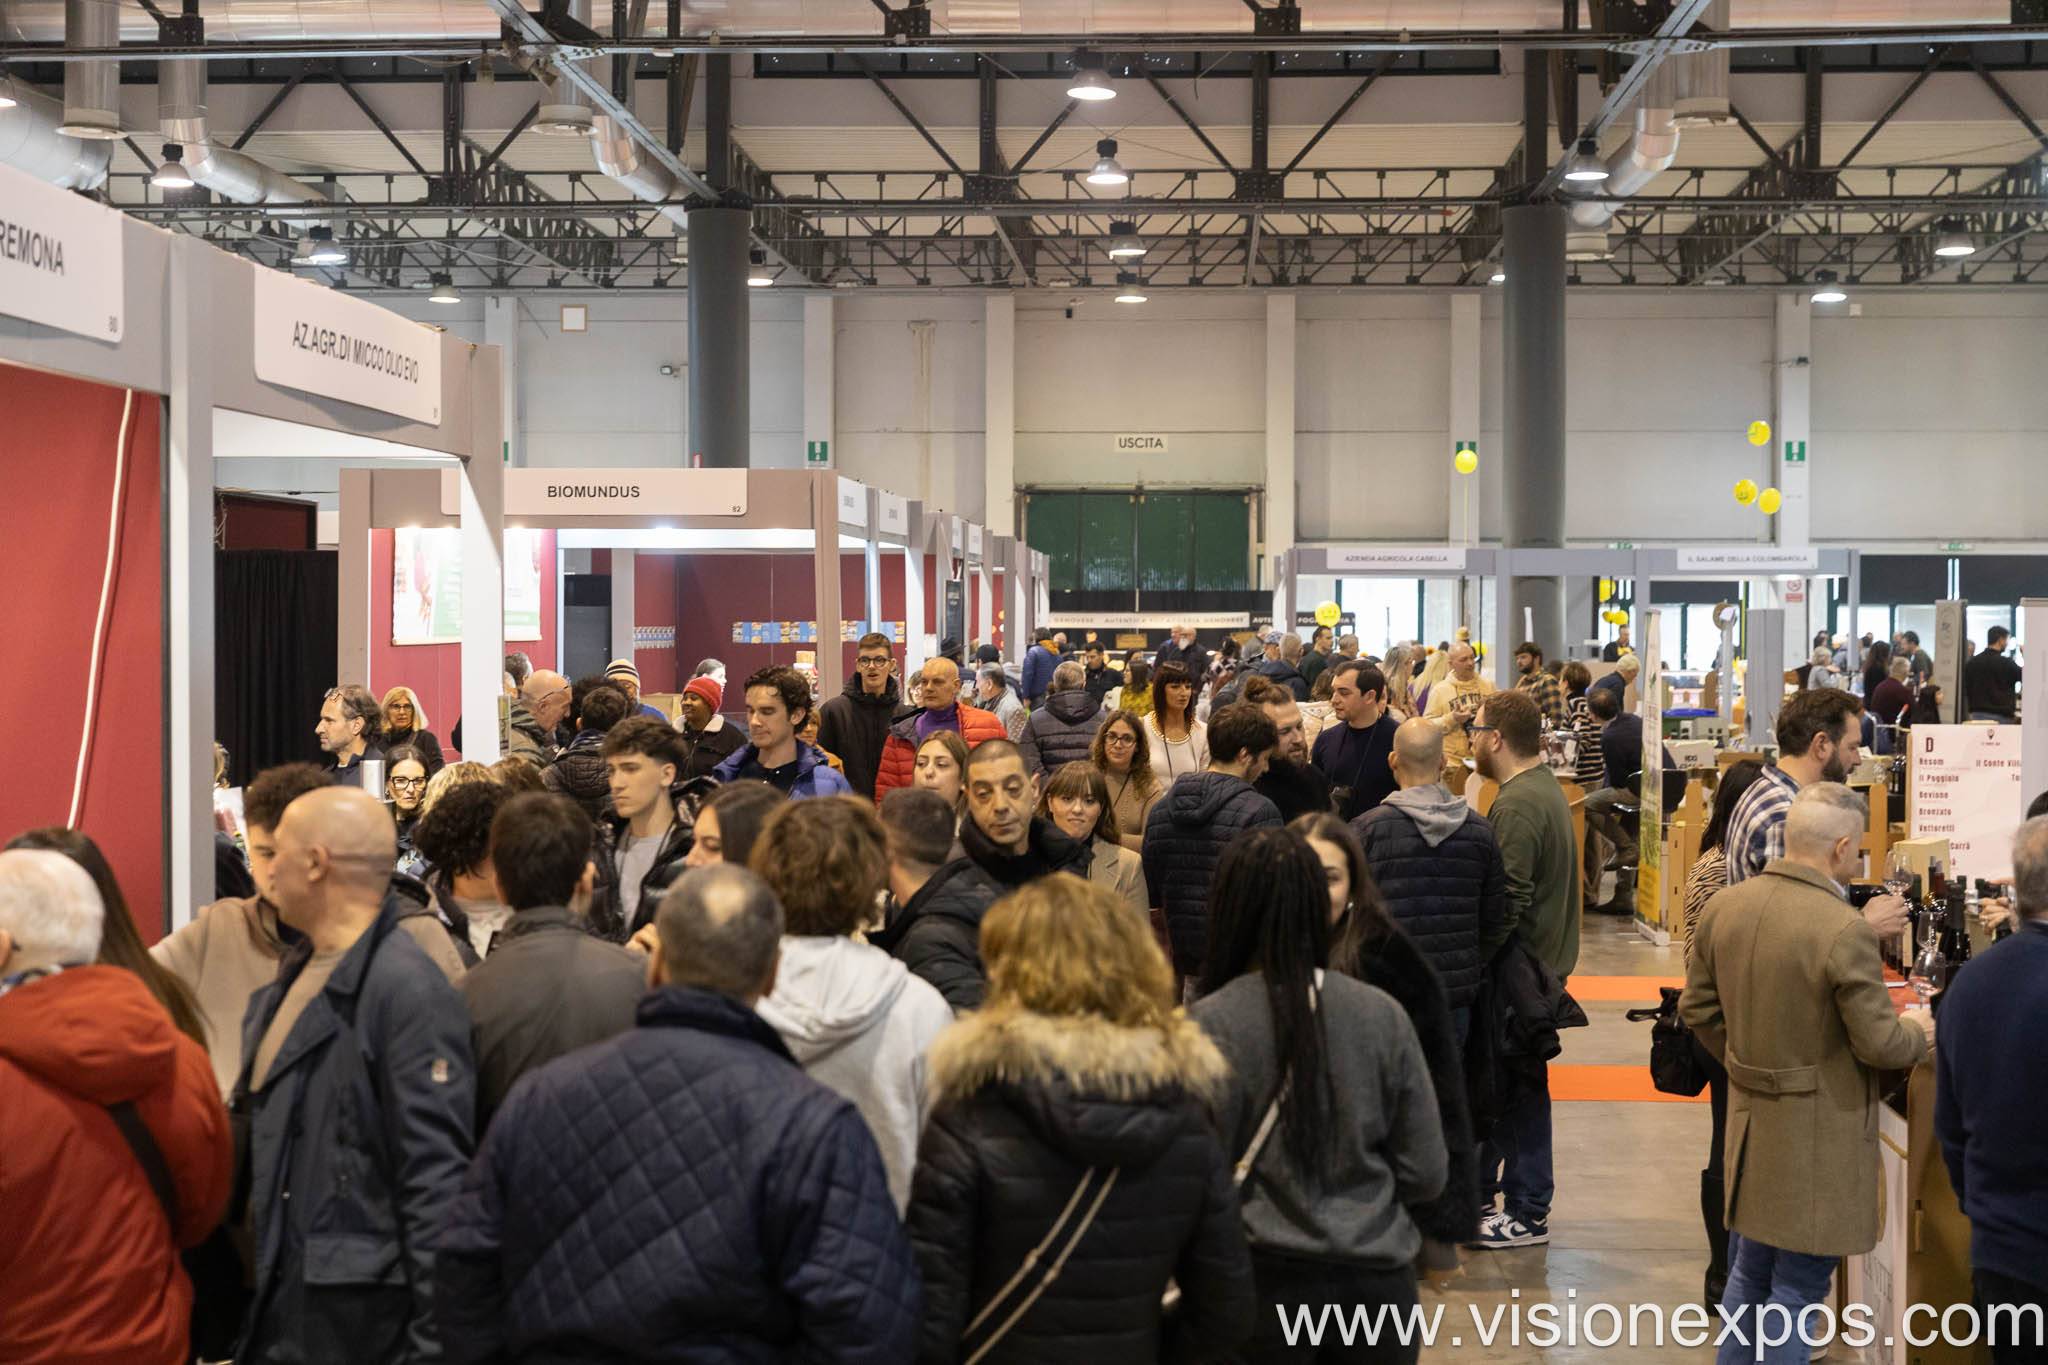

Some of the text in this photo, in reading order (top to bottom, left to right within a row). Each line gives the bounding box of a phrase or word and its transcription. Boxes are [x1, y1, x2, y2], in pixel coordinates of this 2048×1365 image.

[292, 320, 419, 384] AZ.AGR.DI MICCO OLIO EVO
[1118, 437, 1164, 448] USCITA
[547, 485, 640, 498] BIOMUNDUS
[1983, 759, 2005, 767] Conte
